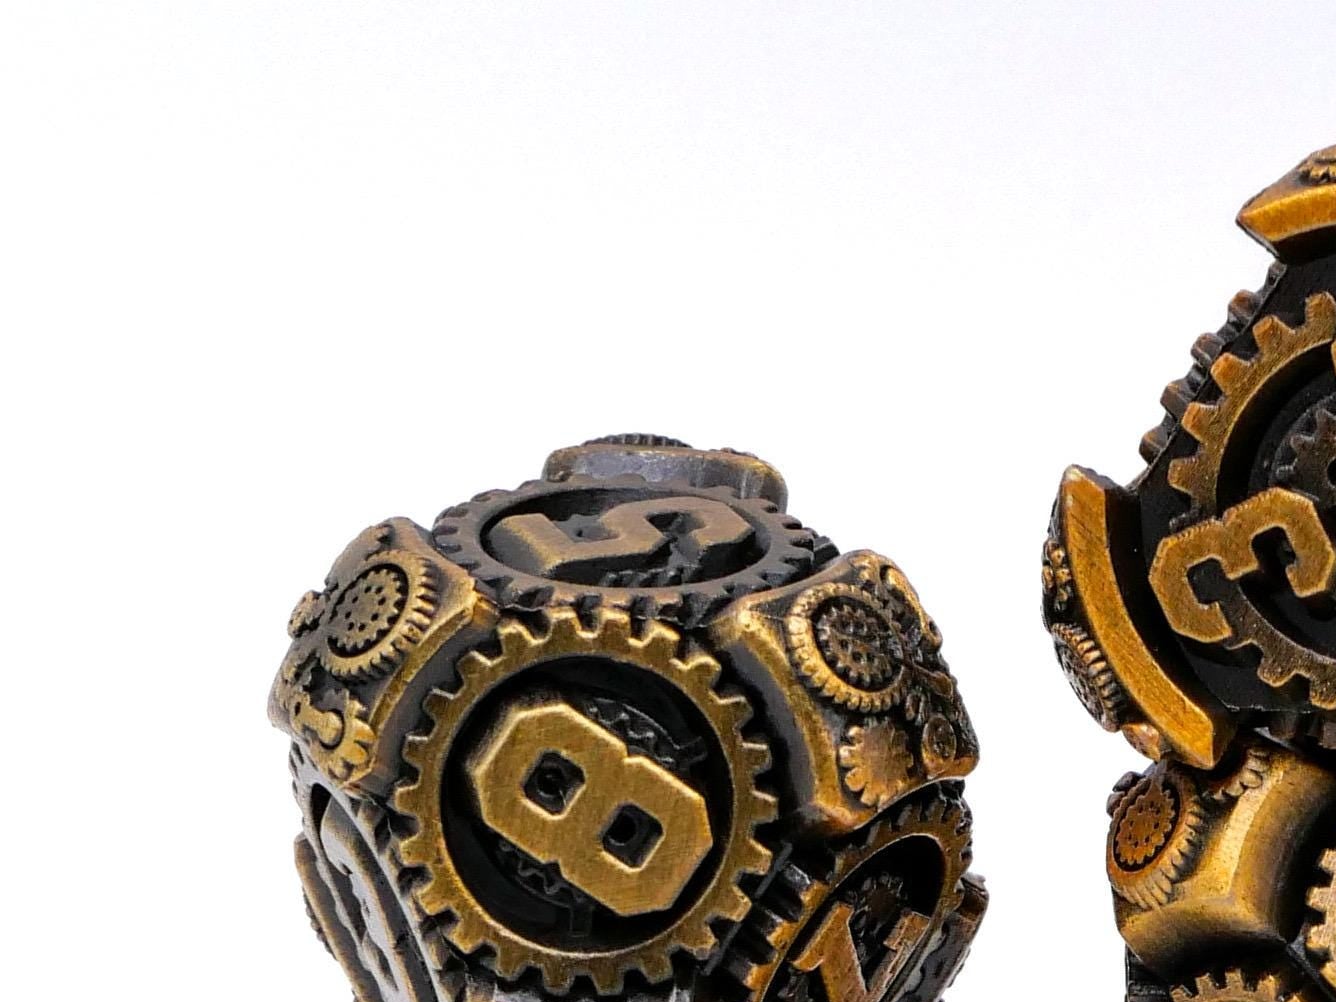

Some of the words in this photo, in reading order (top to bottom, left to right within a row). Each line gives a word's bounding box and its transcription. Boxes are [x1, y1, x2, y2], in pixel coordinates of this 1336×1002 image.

[497, 497, 756, 577] 5
[1149, 488, 1336, 642] 3
[474, 705, 713, 917] 8
